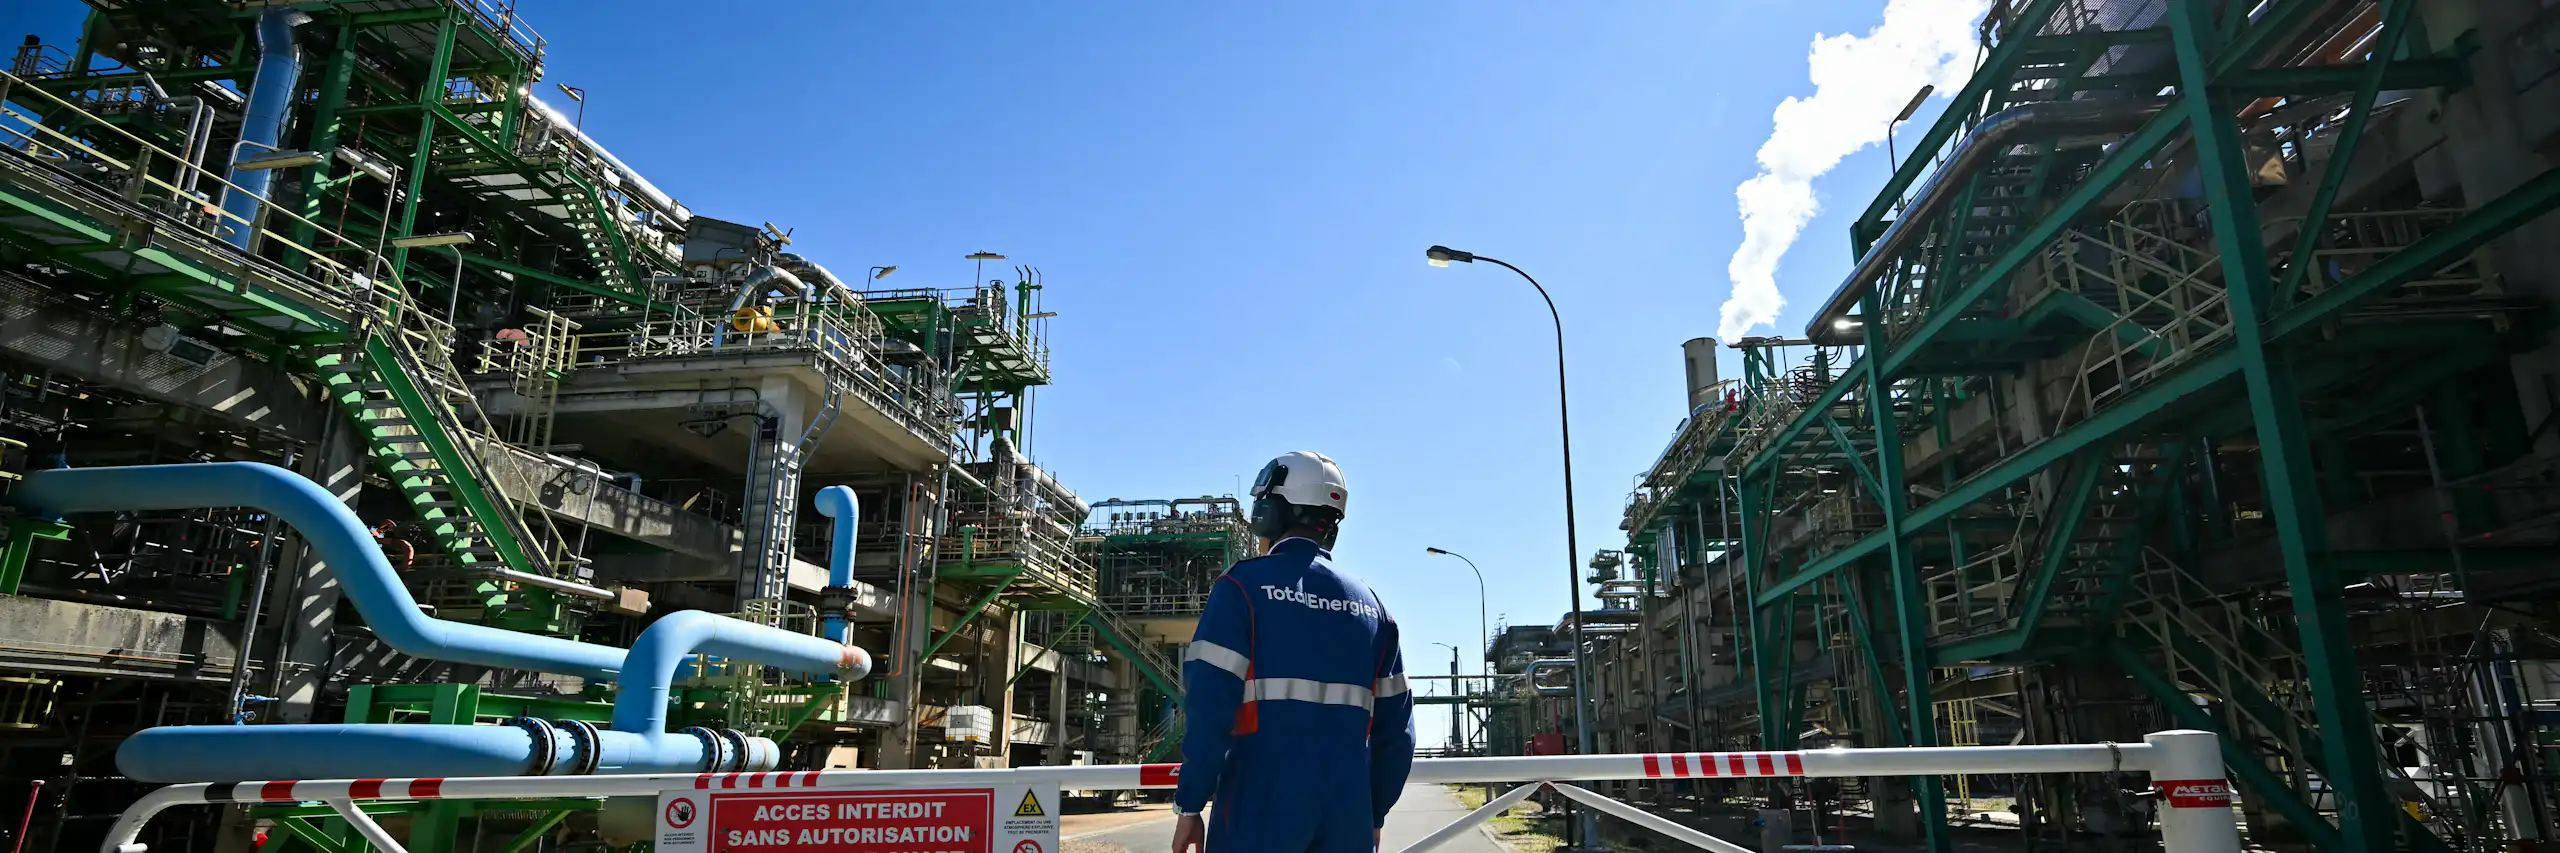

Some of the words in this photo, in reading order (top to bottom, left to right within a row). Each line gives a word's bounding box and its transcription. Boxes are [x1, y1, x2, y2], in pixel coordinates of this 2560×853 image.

[1260, 584, 1379, 619] TotalEnergies
[753, 804, 829, 821] ACCES
[838, 802, 946, 820] INTERDIT
[1024, 804, 1036, 812] EX
[728, 829, 790, 847] SANS
[797, 826, 970, 846] AUTORISATION
